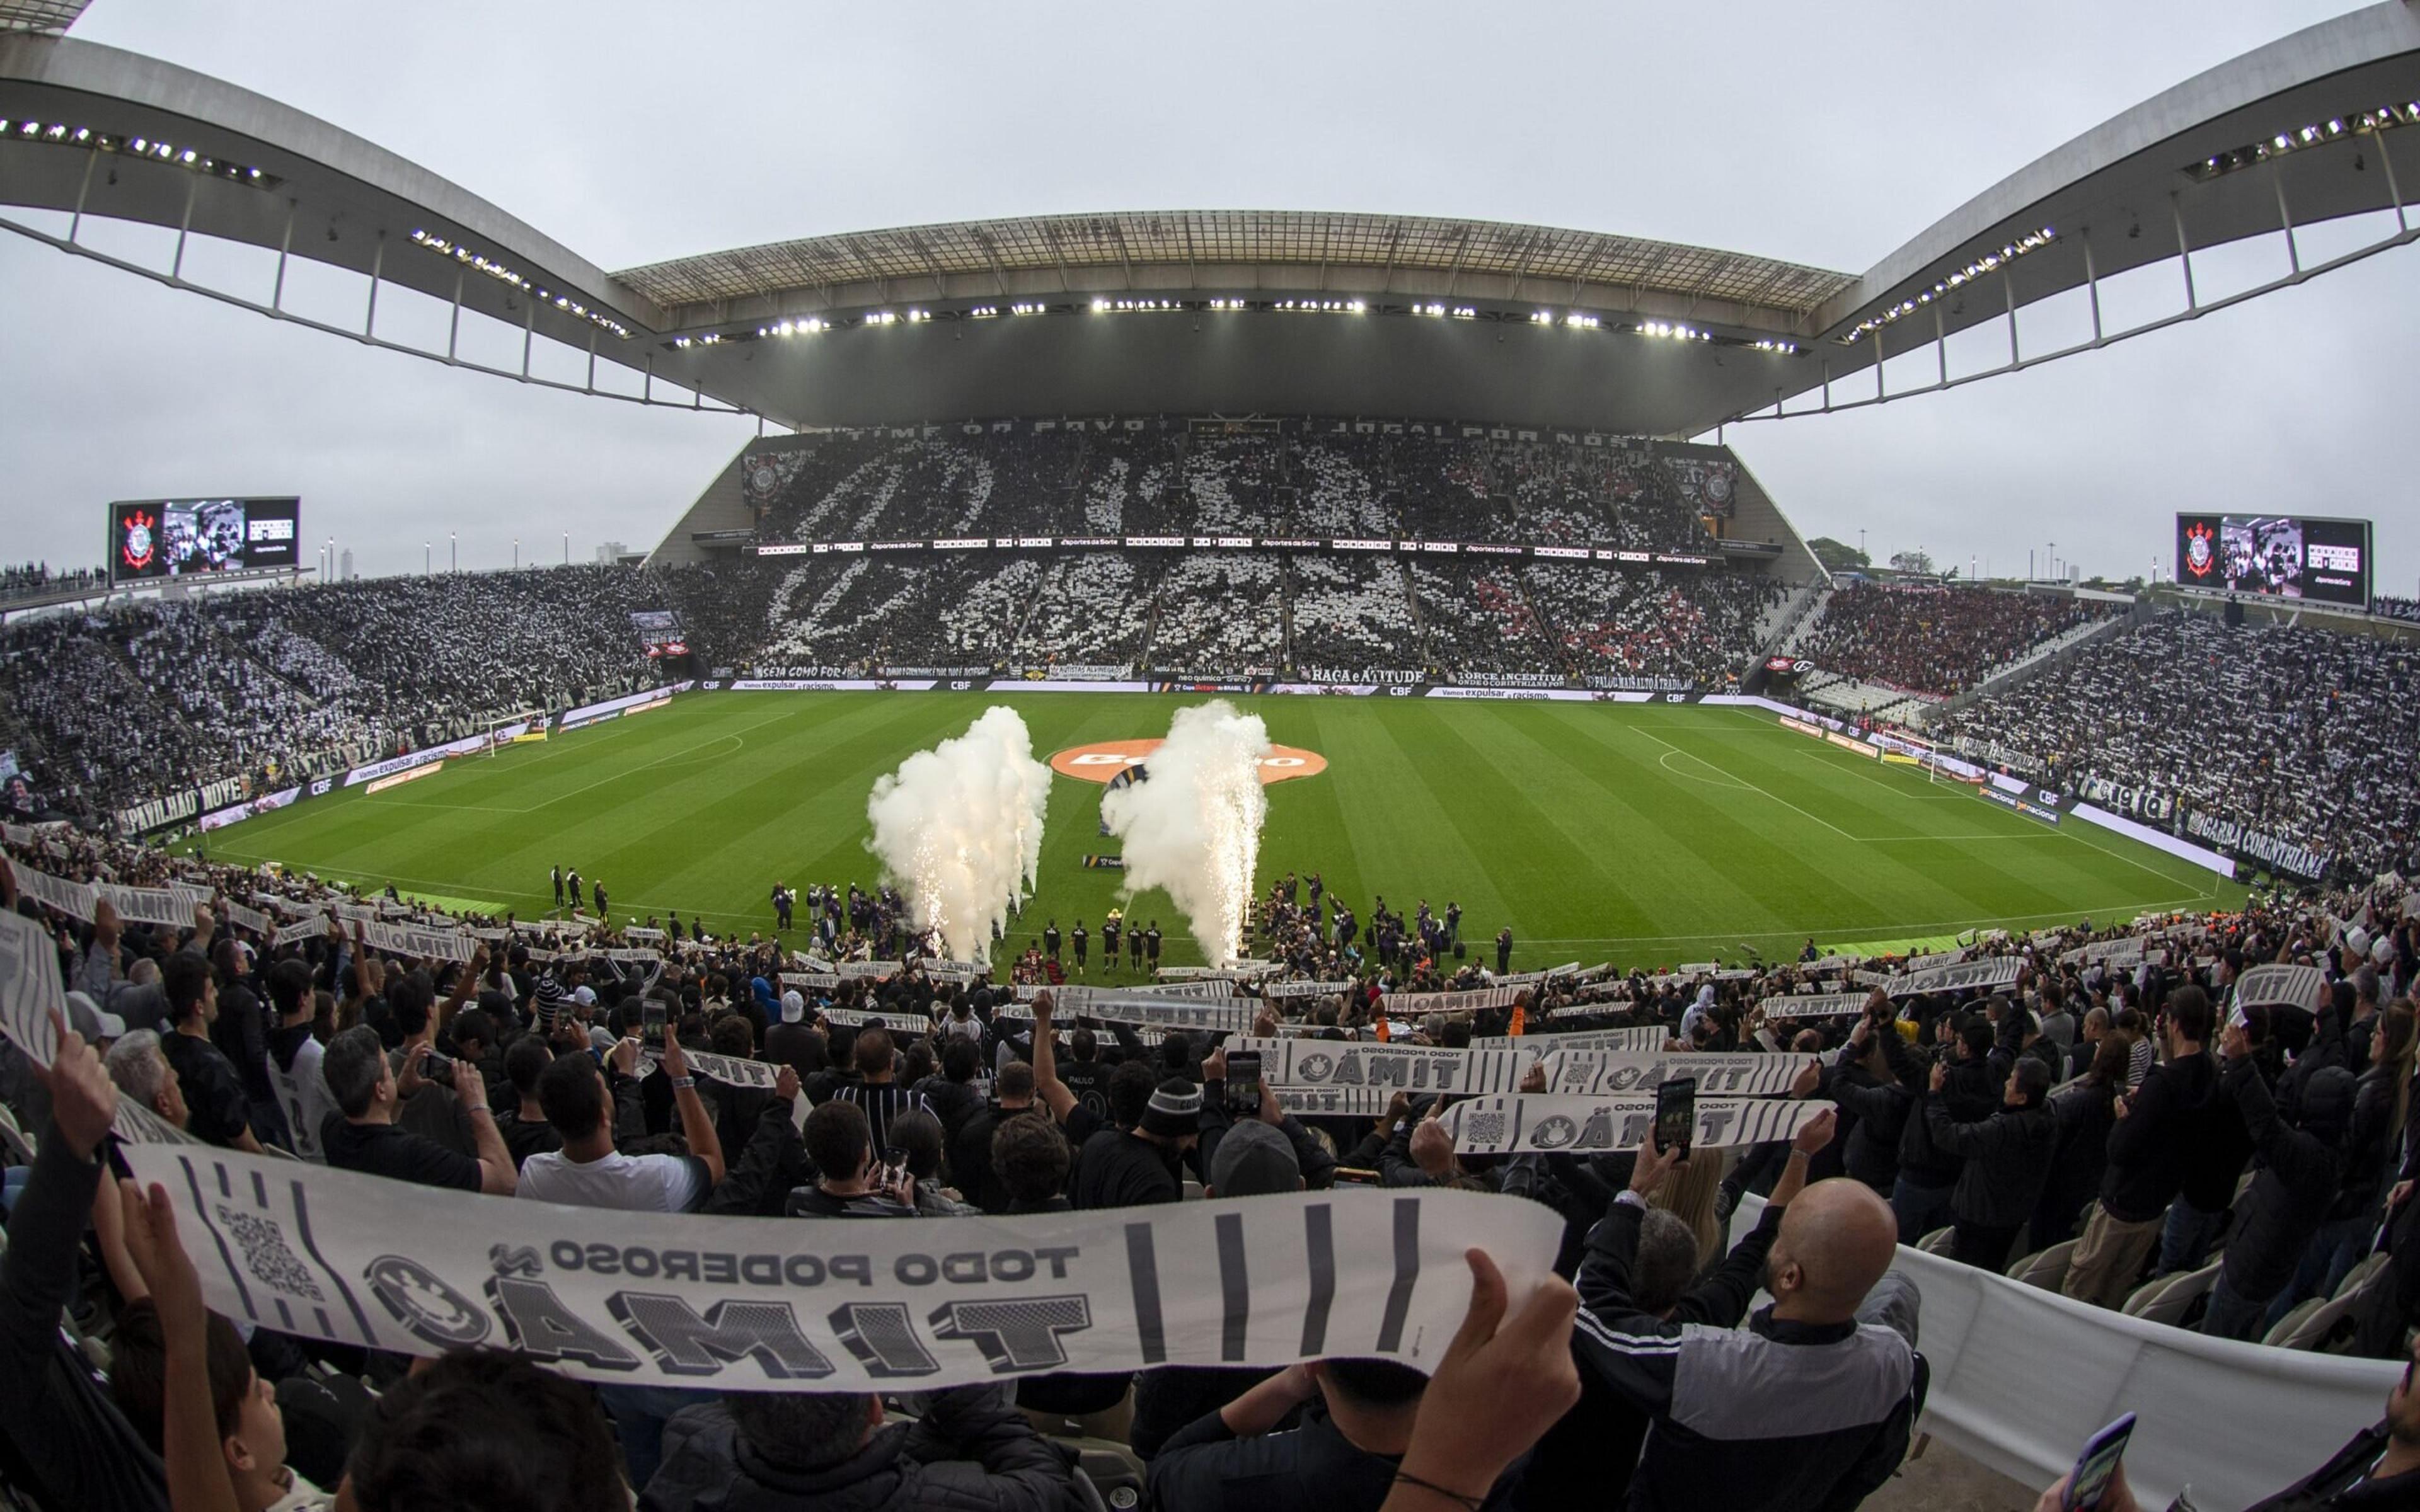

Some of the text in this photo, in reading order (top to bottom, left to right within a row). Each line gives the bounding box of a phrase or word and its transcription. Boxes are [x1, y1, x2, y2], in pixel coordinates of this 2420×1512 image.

[763, 666, 841, 677] SEJA COMO FOR
[1312, 670, 1351, 683] RAÇA
[1458, 672, 1497, 680] TORCE
[703, 681, 720, 689] CBF
[763, 680, 796, 690] expulsar
[950, 681, 971, 690] CBF
[1390, 687, 1411, 696] CBF
[1465, 688, 1506, 697] expulsar
[1667, 694, 1685, 702] CBF
[1848, 726, 1860, 737] CBF
[357, 740, 378, 763] 12
[359, 768, 378, 779] Vamos
[379, 757, 413, 774] expulsar
[311, 779, 331, 795] CBF
[201, 776, 242, 811] NOVE
[2039, 789, 2058, 806] CBF
[2202, 816, 2242, 849] GARRA
[1069, 1077, 1094, 1085] PAULO
